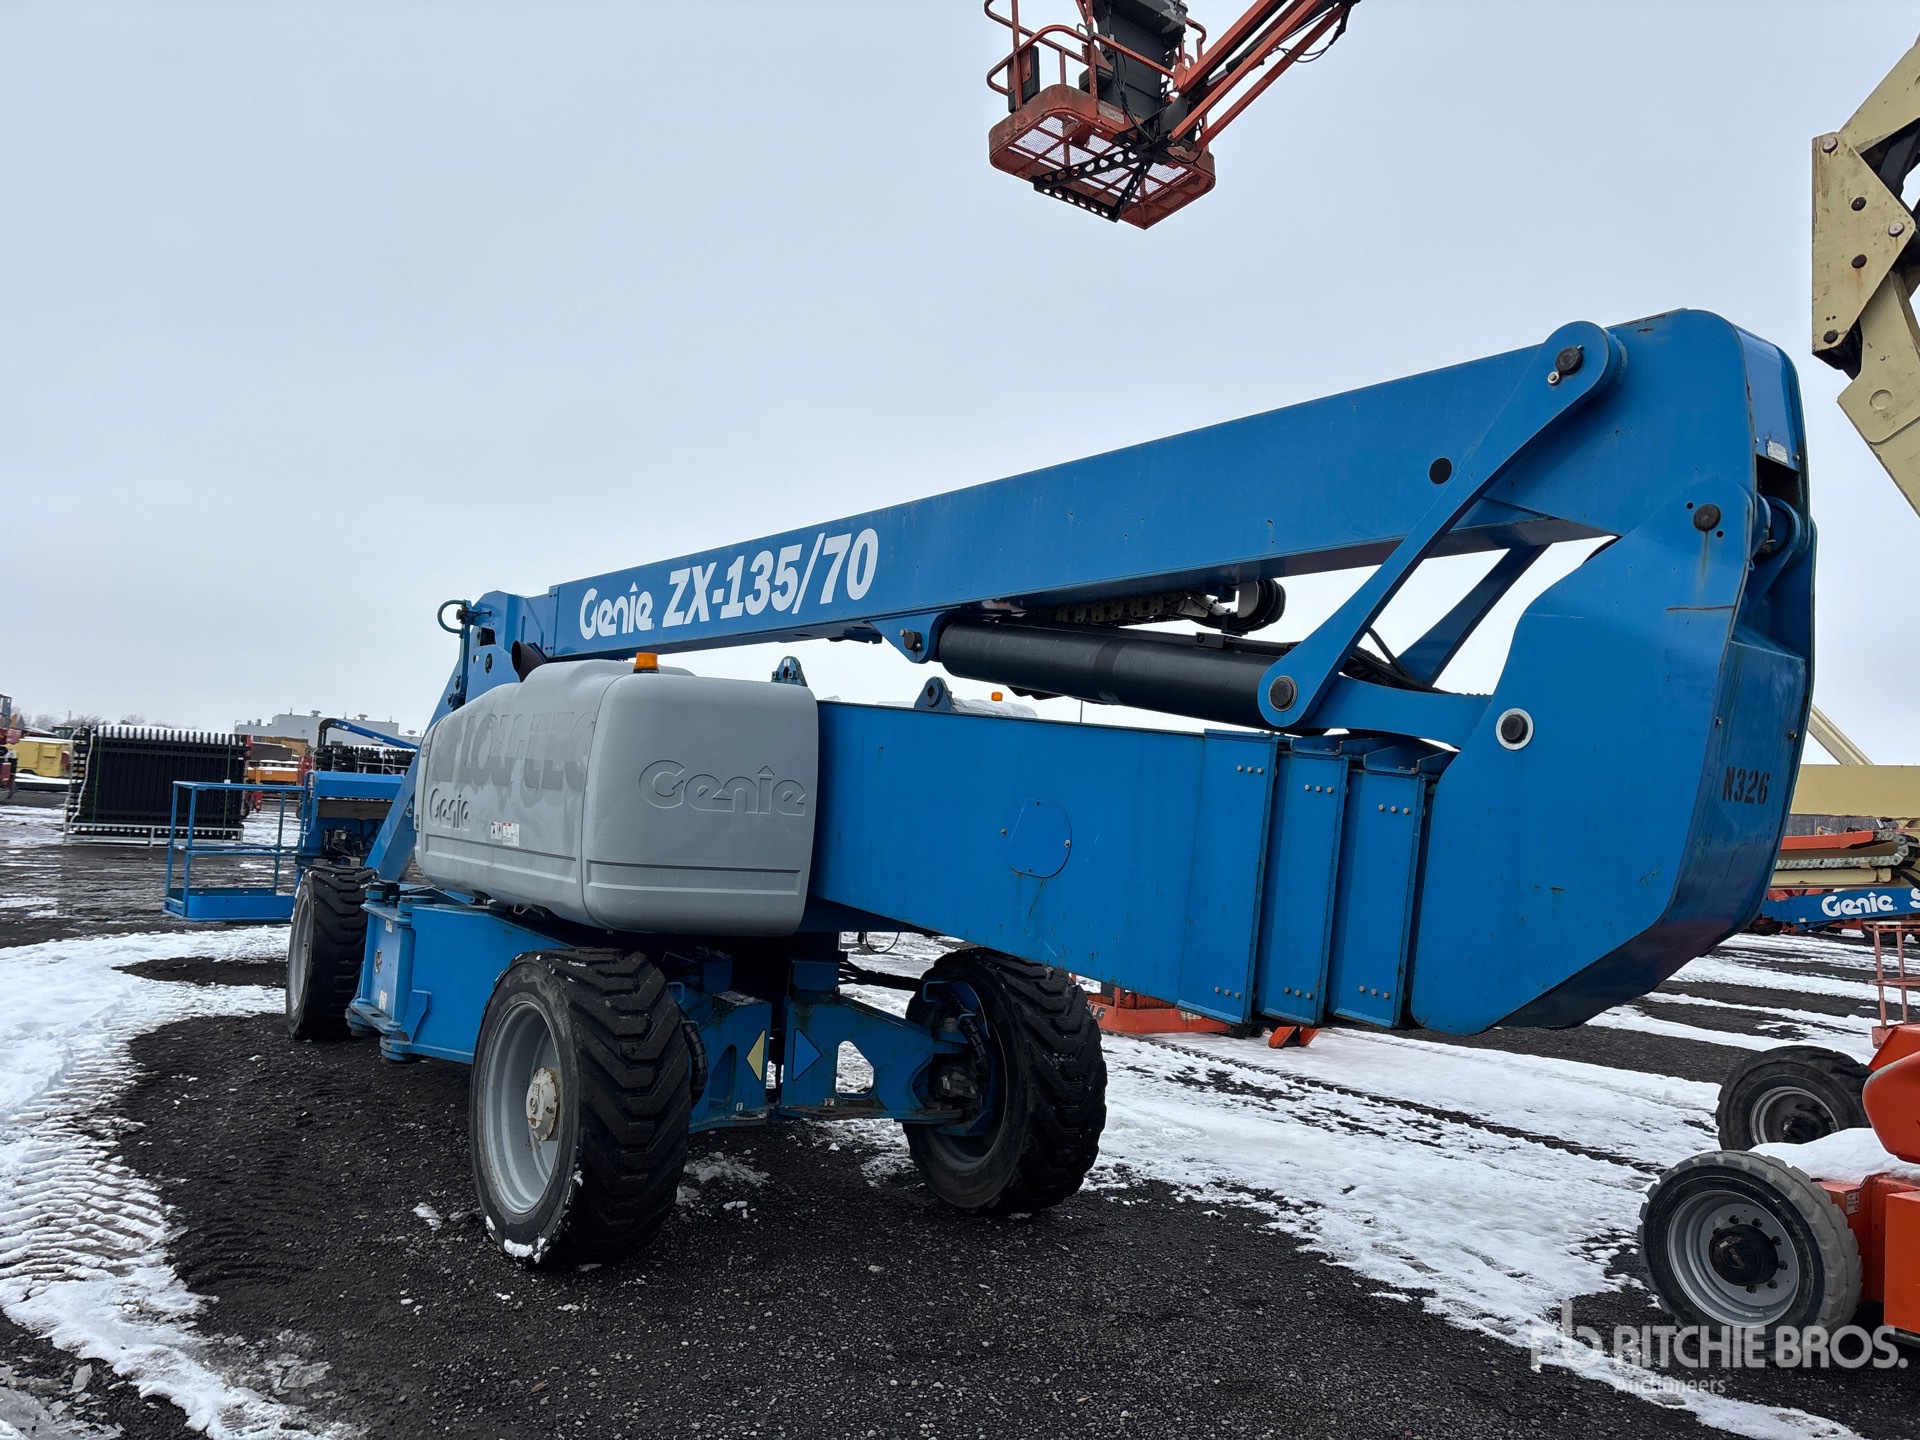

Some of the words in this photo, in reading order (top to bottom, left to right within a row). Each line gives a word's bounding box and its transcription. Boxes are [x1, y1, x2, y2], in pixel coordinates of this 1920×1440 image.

[580, 582, 653, 640] Genie
[662, 528, 879, 628] ZX-135/70
[638, 759, 807, 817] Genie
[1722, 766, 1771, 805] N326
[1821, 892, 1894, 917] Genie
